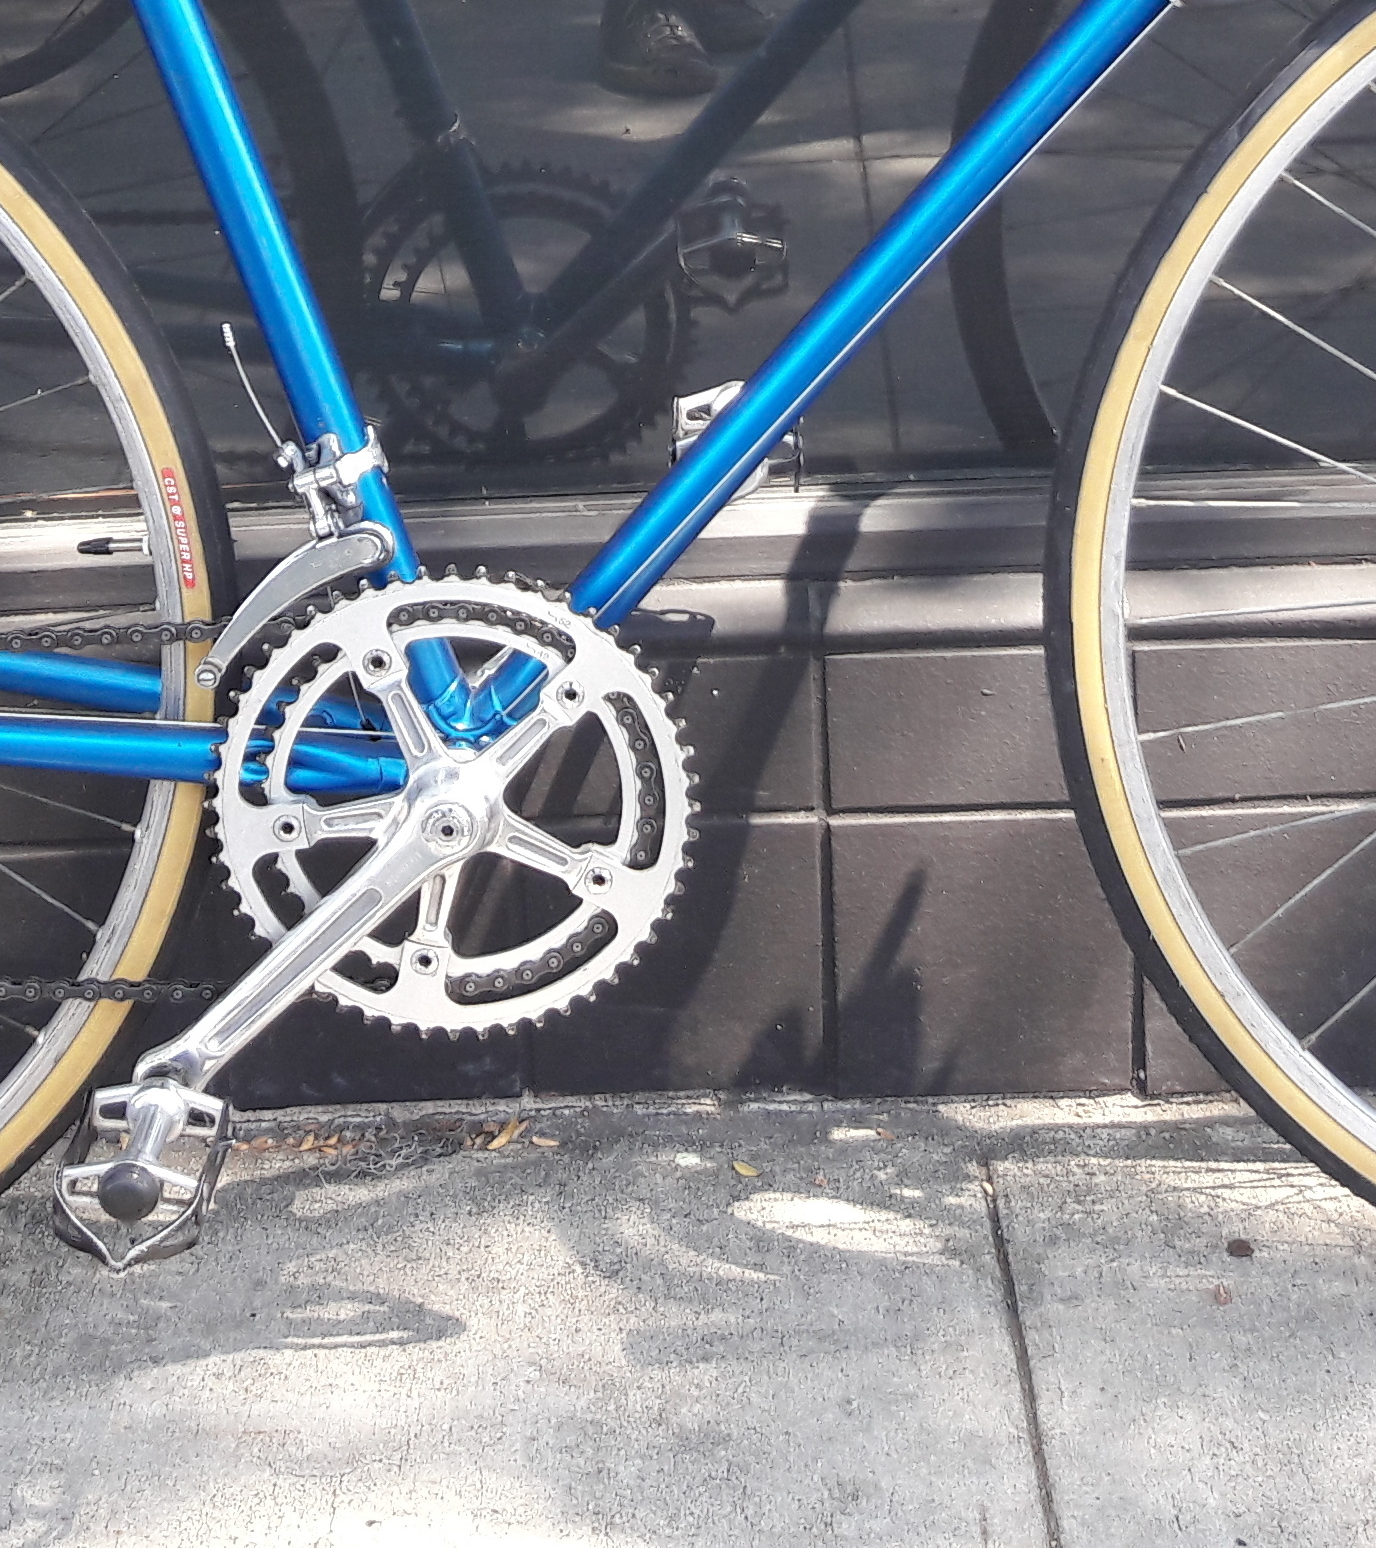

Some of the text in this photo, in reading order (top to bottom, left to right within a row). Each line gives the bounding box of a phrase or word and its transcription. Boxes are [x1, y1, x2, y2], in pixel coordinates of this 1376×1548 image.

[164, 477, 194, 580] CST SUPER HP
